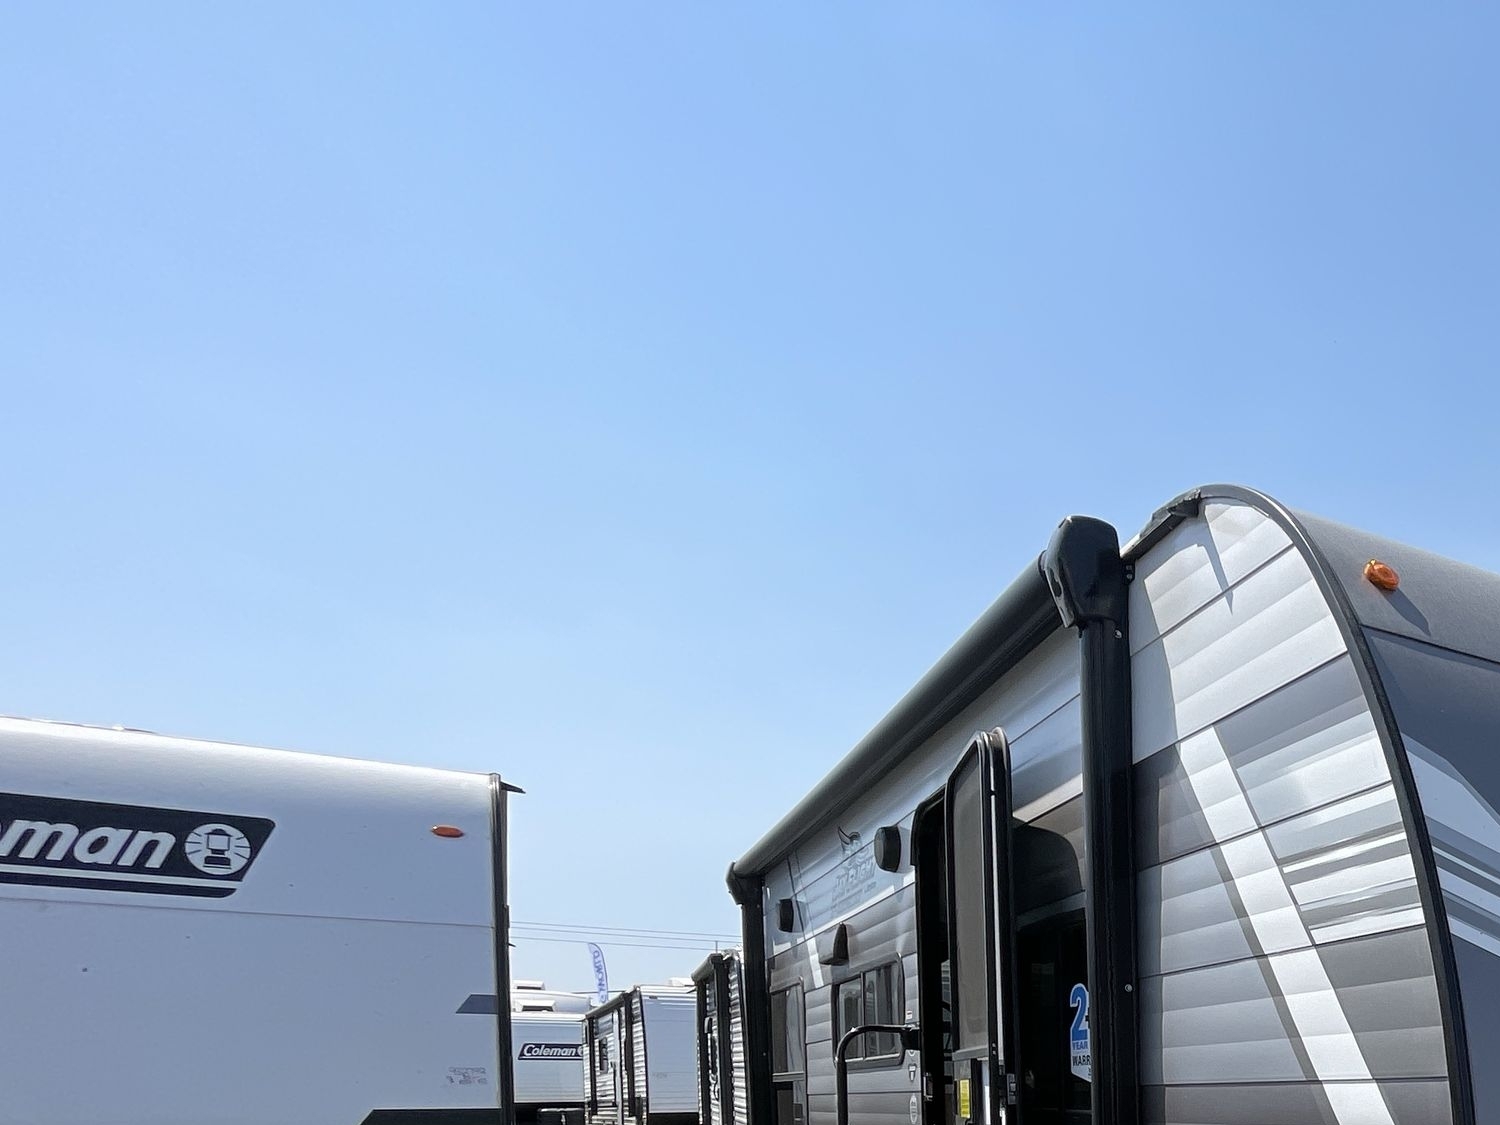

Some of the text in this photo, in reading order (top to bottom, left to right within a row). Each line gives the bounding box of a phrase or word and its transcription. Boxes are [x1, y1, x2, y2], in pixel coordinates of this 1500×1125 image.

[0, 819, 176, 869] man
[1070, 985, 1089, 1041] 2
[523, 1044, 577, 1056] Coleman
[1072, 1041, 1089, 1051] YEAR
[1072, 1055, 1091, 1067] WARR
